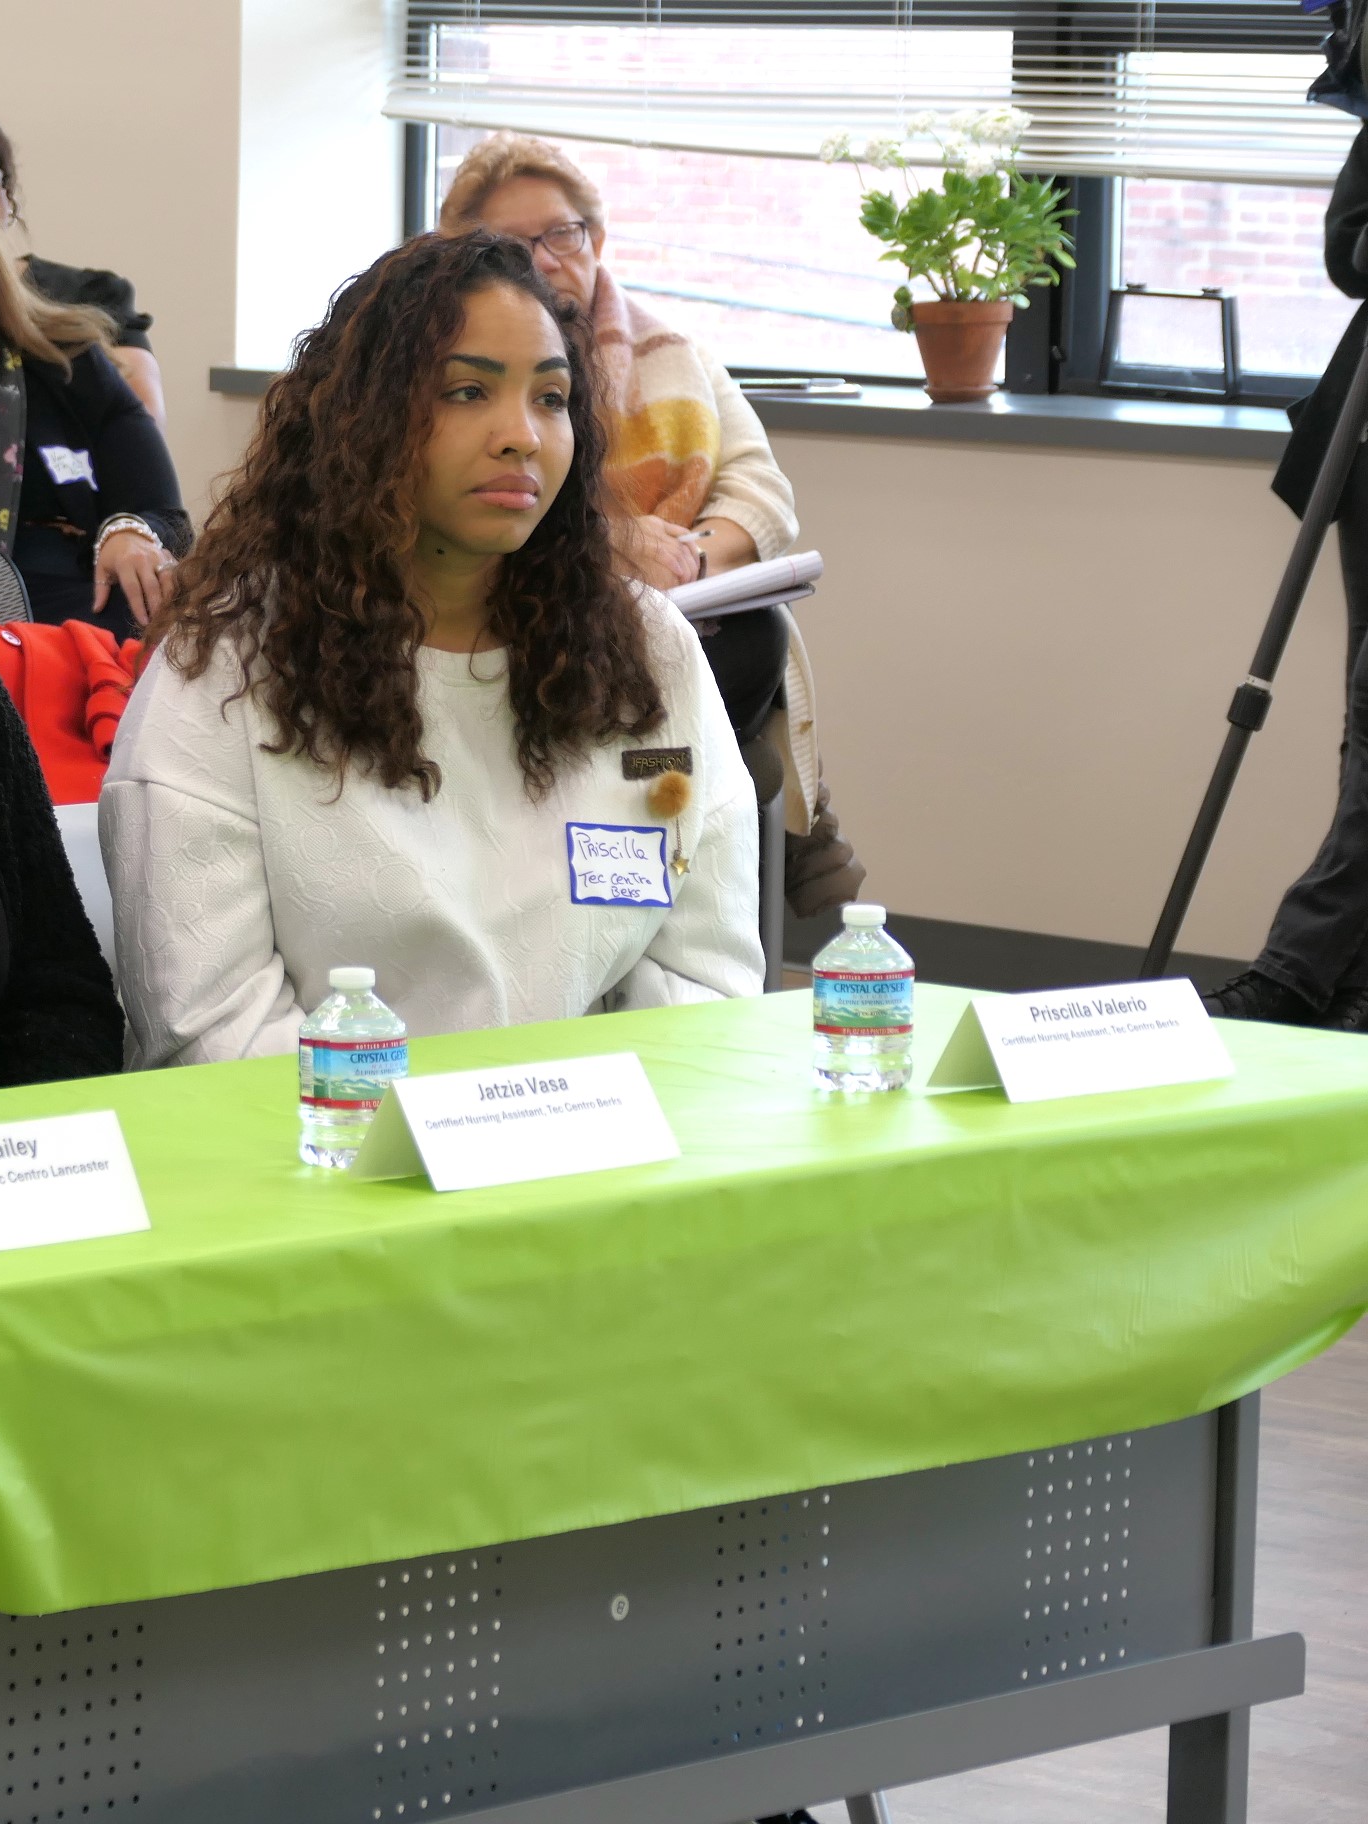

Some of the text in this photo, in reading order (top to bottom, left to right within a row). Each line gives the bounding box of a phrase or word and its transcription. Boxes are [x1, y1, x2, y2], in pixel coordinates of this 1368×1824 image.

[578, 870, 607, 888] Tec
[833, 983, 871, 994] CRYSTAL
[873, 982, 906, 993] GEYSER
[1029, 996, 1147, 1023] Priscilla Valerio
[1001, 1019, 1180, 1047] Certified Nursing Assistant, Tec Centro Berks
[350, 1052, 388, 1064] CRYSTAL
[477, 1076, 569, 1101] Jatzia Vasa
[425, 1096, 623, 1130] Certified Nursing Assistant, Tec Centro Berks
[7, 1167, 49, 1184] Centro
[50, 1159, 110, 1178] Lancaster
